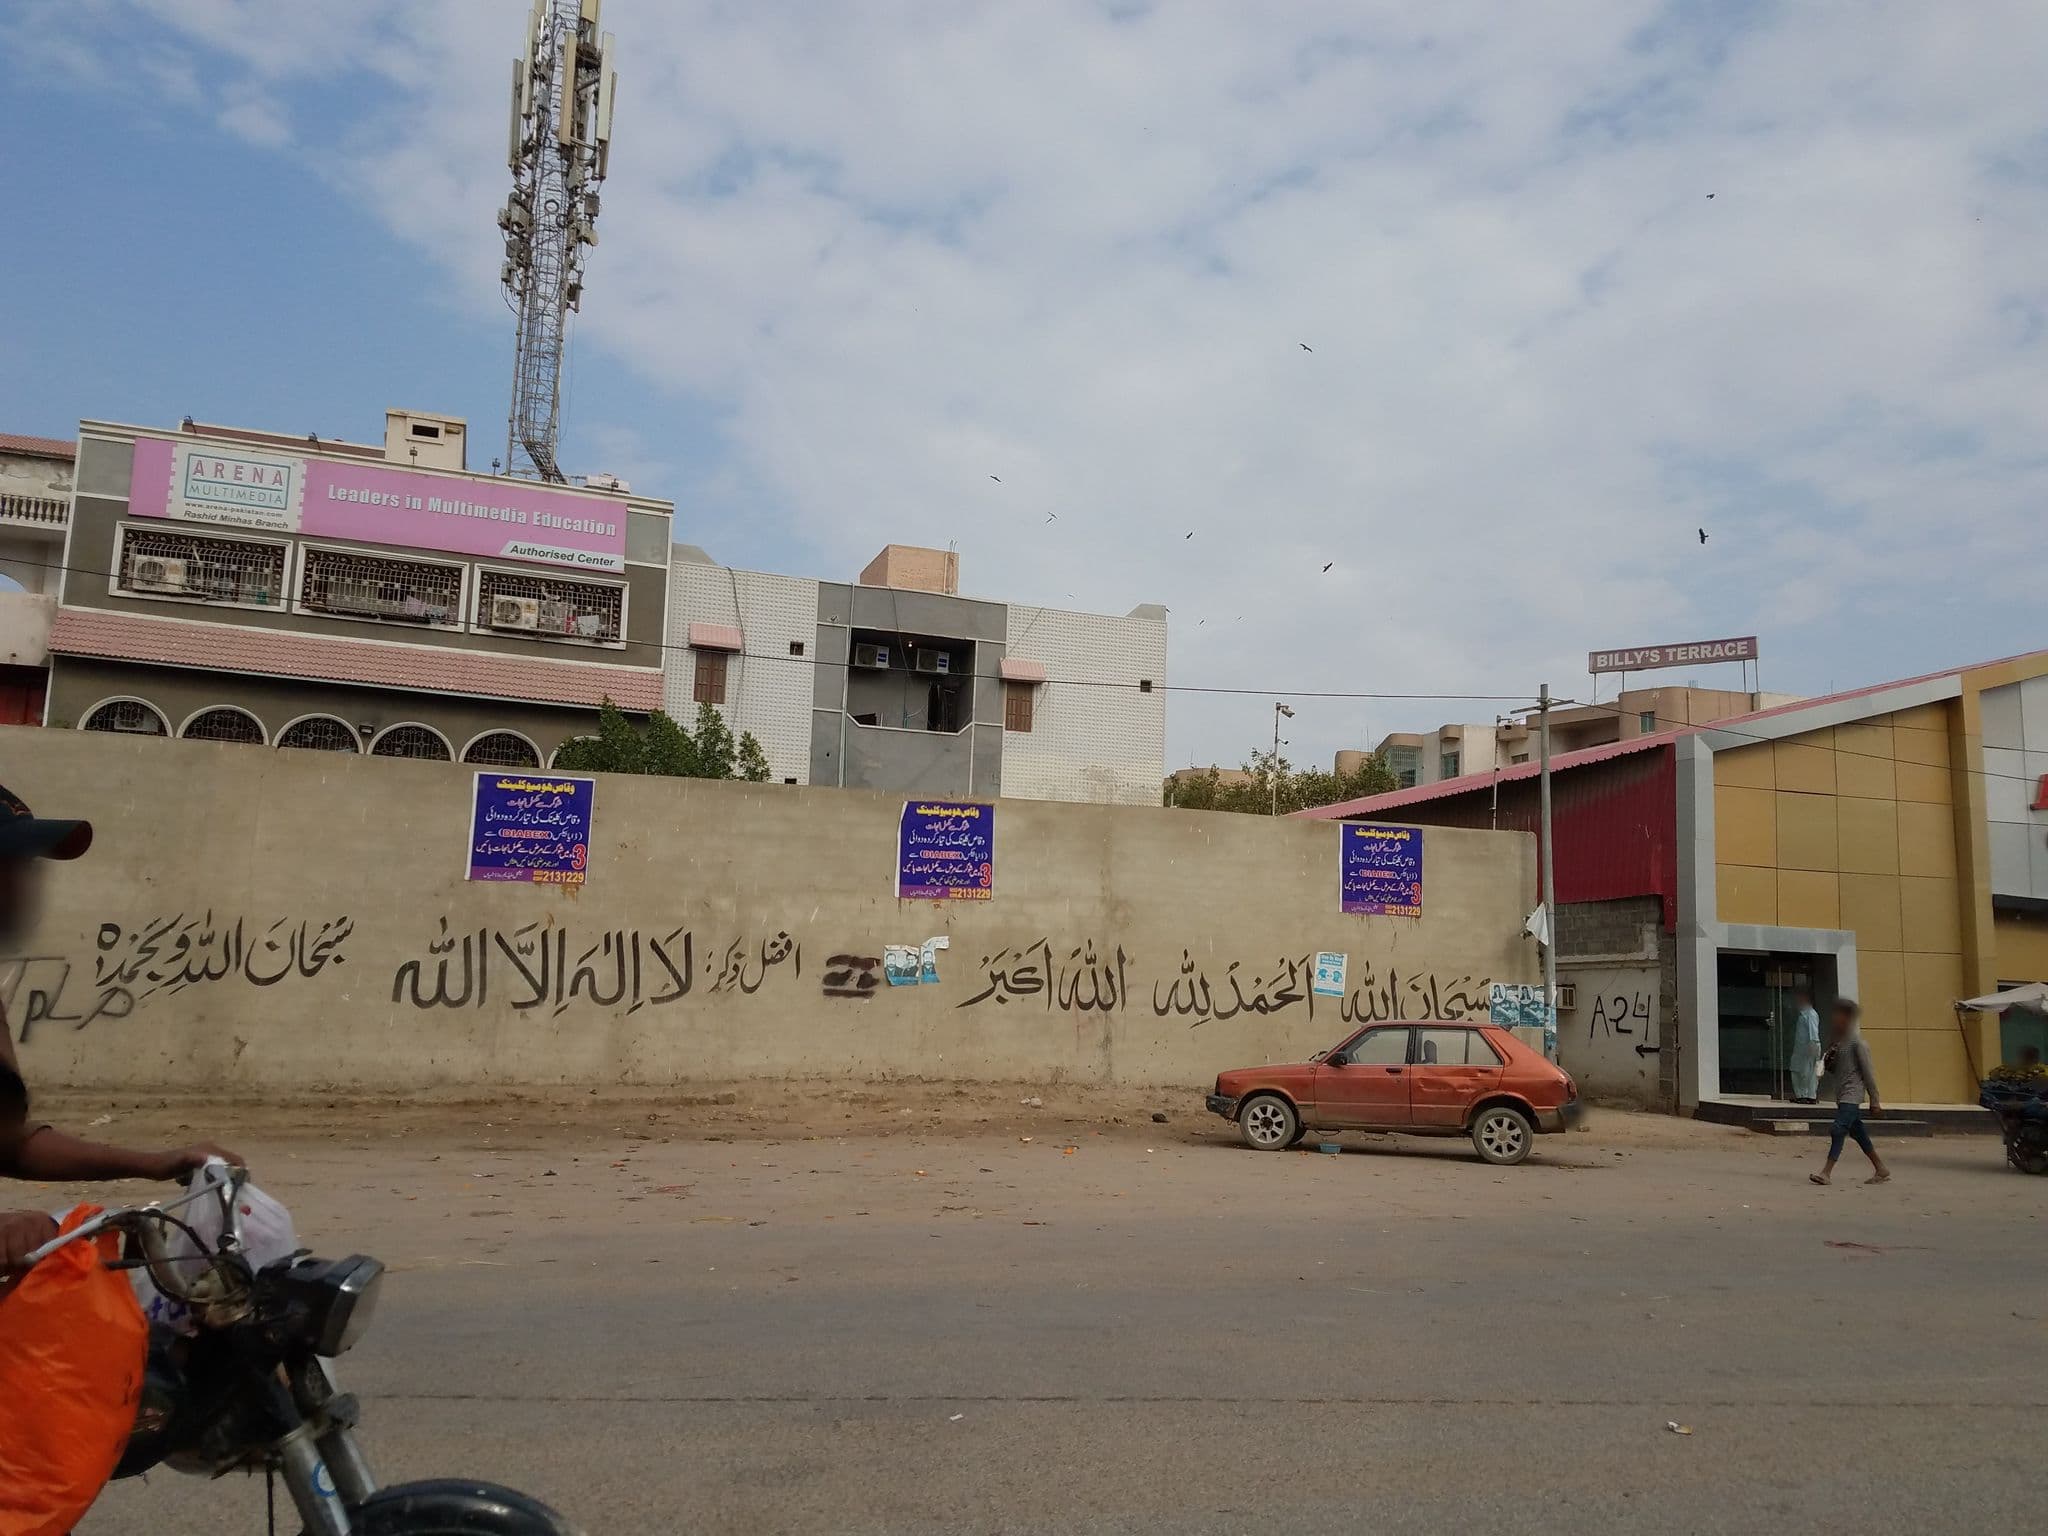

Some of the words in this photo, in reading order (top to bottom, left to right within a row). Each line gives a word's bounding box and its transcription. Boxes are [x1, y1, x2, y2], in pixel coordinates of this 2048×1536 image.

[193, 459, 283, 486] ARENA
[189, 485, 283, 504] MULTIMEDIA
[184, 510, 217, 521] Rashid
[219, 514, 253, 526] Minhas
[255, 518, 289, 529] Branch
[185, 503, 283, 518] www.arena-pakistan.com
[328, 484, 400, 508] Leaders
[405, 494, 422, 511] in
[428, 496, 527, 524] Multimedia
[533, 511, 617, 537] Education
[510, 544, 575, 563] Authorised
[577, 553, 616, 567] Center
[1597, 649, 1660, 668] BILLY'S
[1665, 641, 1748, 662] TERRACE
[571, 843, 586, 870] 3
[543, 870, 585, 883] 2131229
[1590, 992, 1651, 1041] A24
